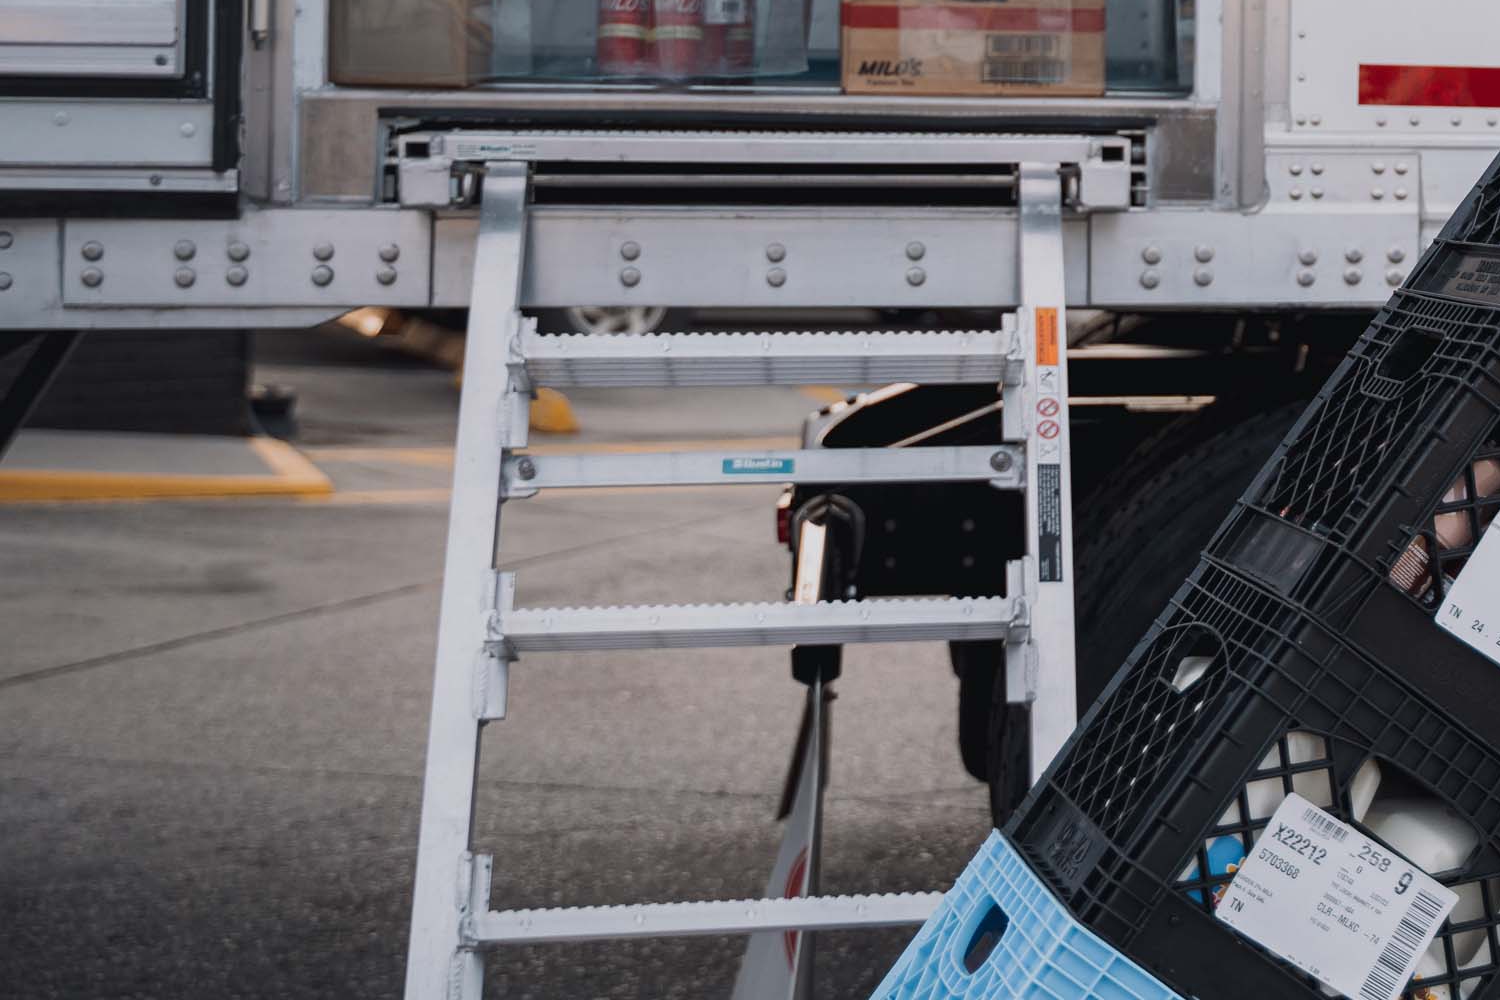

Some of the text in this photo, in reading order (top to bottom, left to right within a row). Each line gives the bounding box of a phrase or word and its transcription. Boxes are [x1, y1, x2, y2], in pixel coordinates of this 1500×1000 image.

[1448, 603, 1463, 620] TN
[1470, 619, 1486, 634] 24
[1258, 848, 1300, 880] 5703368
[1271, 822, 1415, 896] X22212 258 9
[1228, 896, 1245, 913] TN
